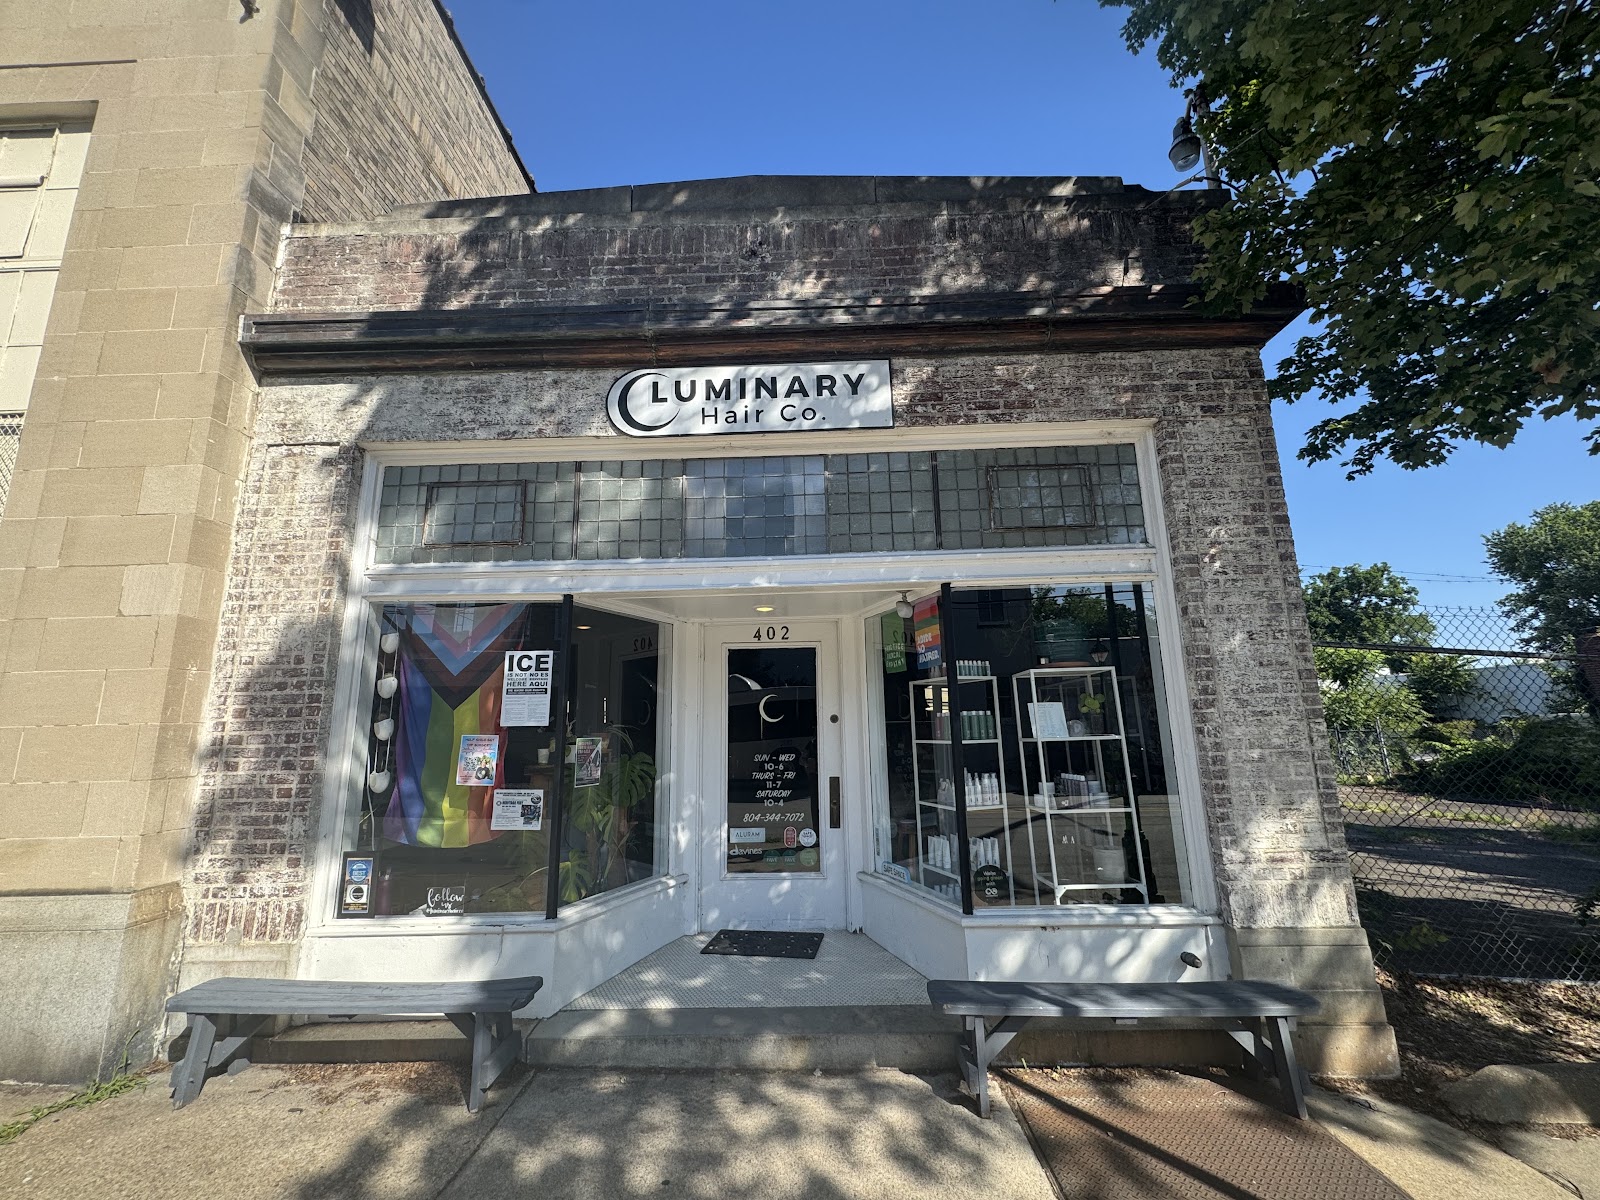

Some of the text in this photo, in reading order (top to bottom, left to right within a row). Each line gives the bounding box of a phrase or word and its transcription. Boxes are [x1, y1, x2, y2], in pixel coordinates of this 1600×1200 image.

[651, 372, 866, 404] LUMINARY
[701, 404, 826, 425] Hair Co.
[753, 626, 790, 641] 402
[507, 654, 550, 672] ICE
[753, 753, 771, 762] SUN
[778, 753, 796, 762] WED
[764, 762, 784, 771] 10-6
[751, 771, 775, 780] THURS
[782, 771, 796, 779] FRI
[765, 780, 782, 789] 11-7
[755, 789, 792, 798] SATURDAY
[763, 798, 784, 807] 10-4
[743, 812, 805, 823] 804-344-7072
[729, 844, 763, 856] davines
[427, 887, 465, 908] follow
